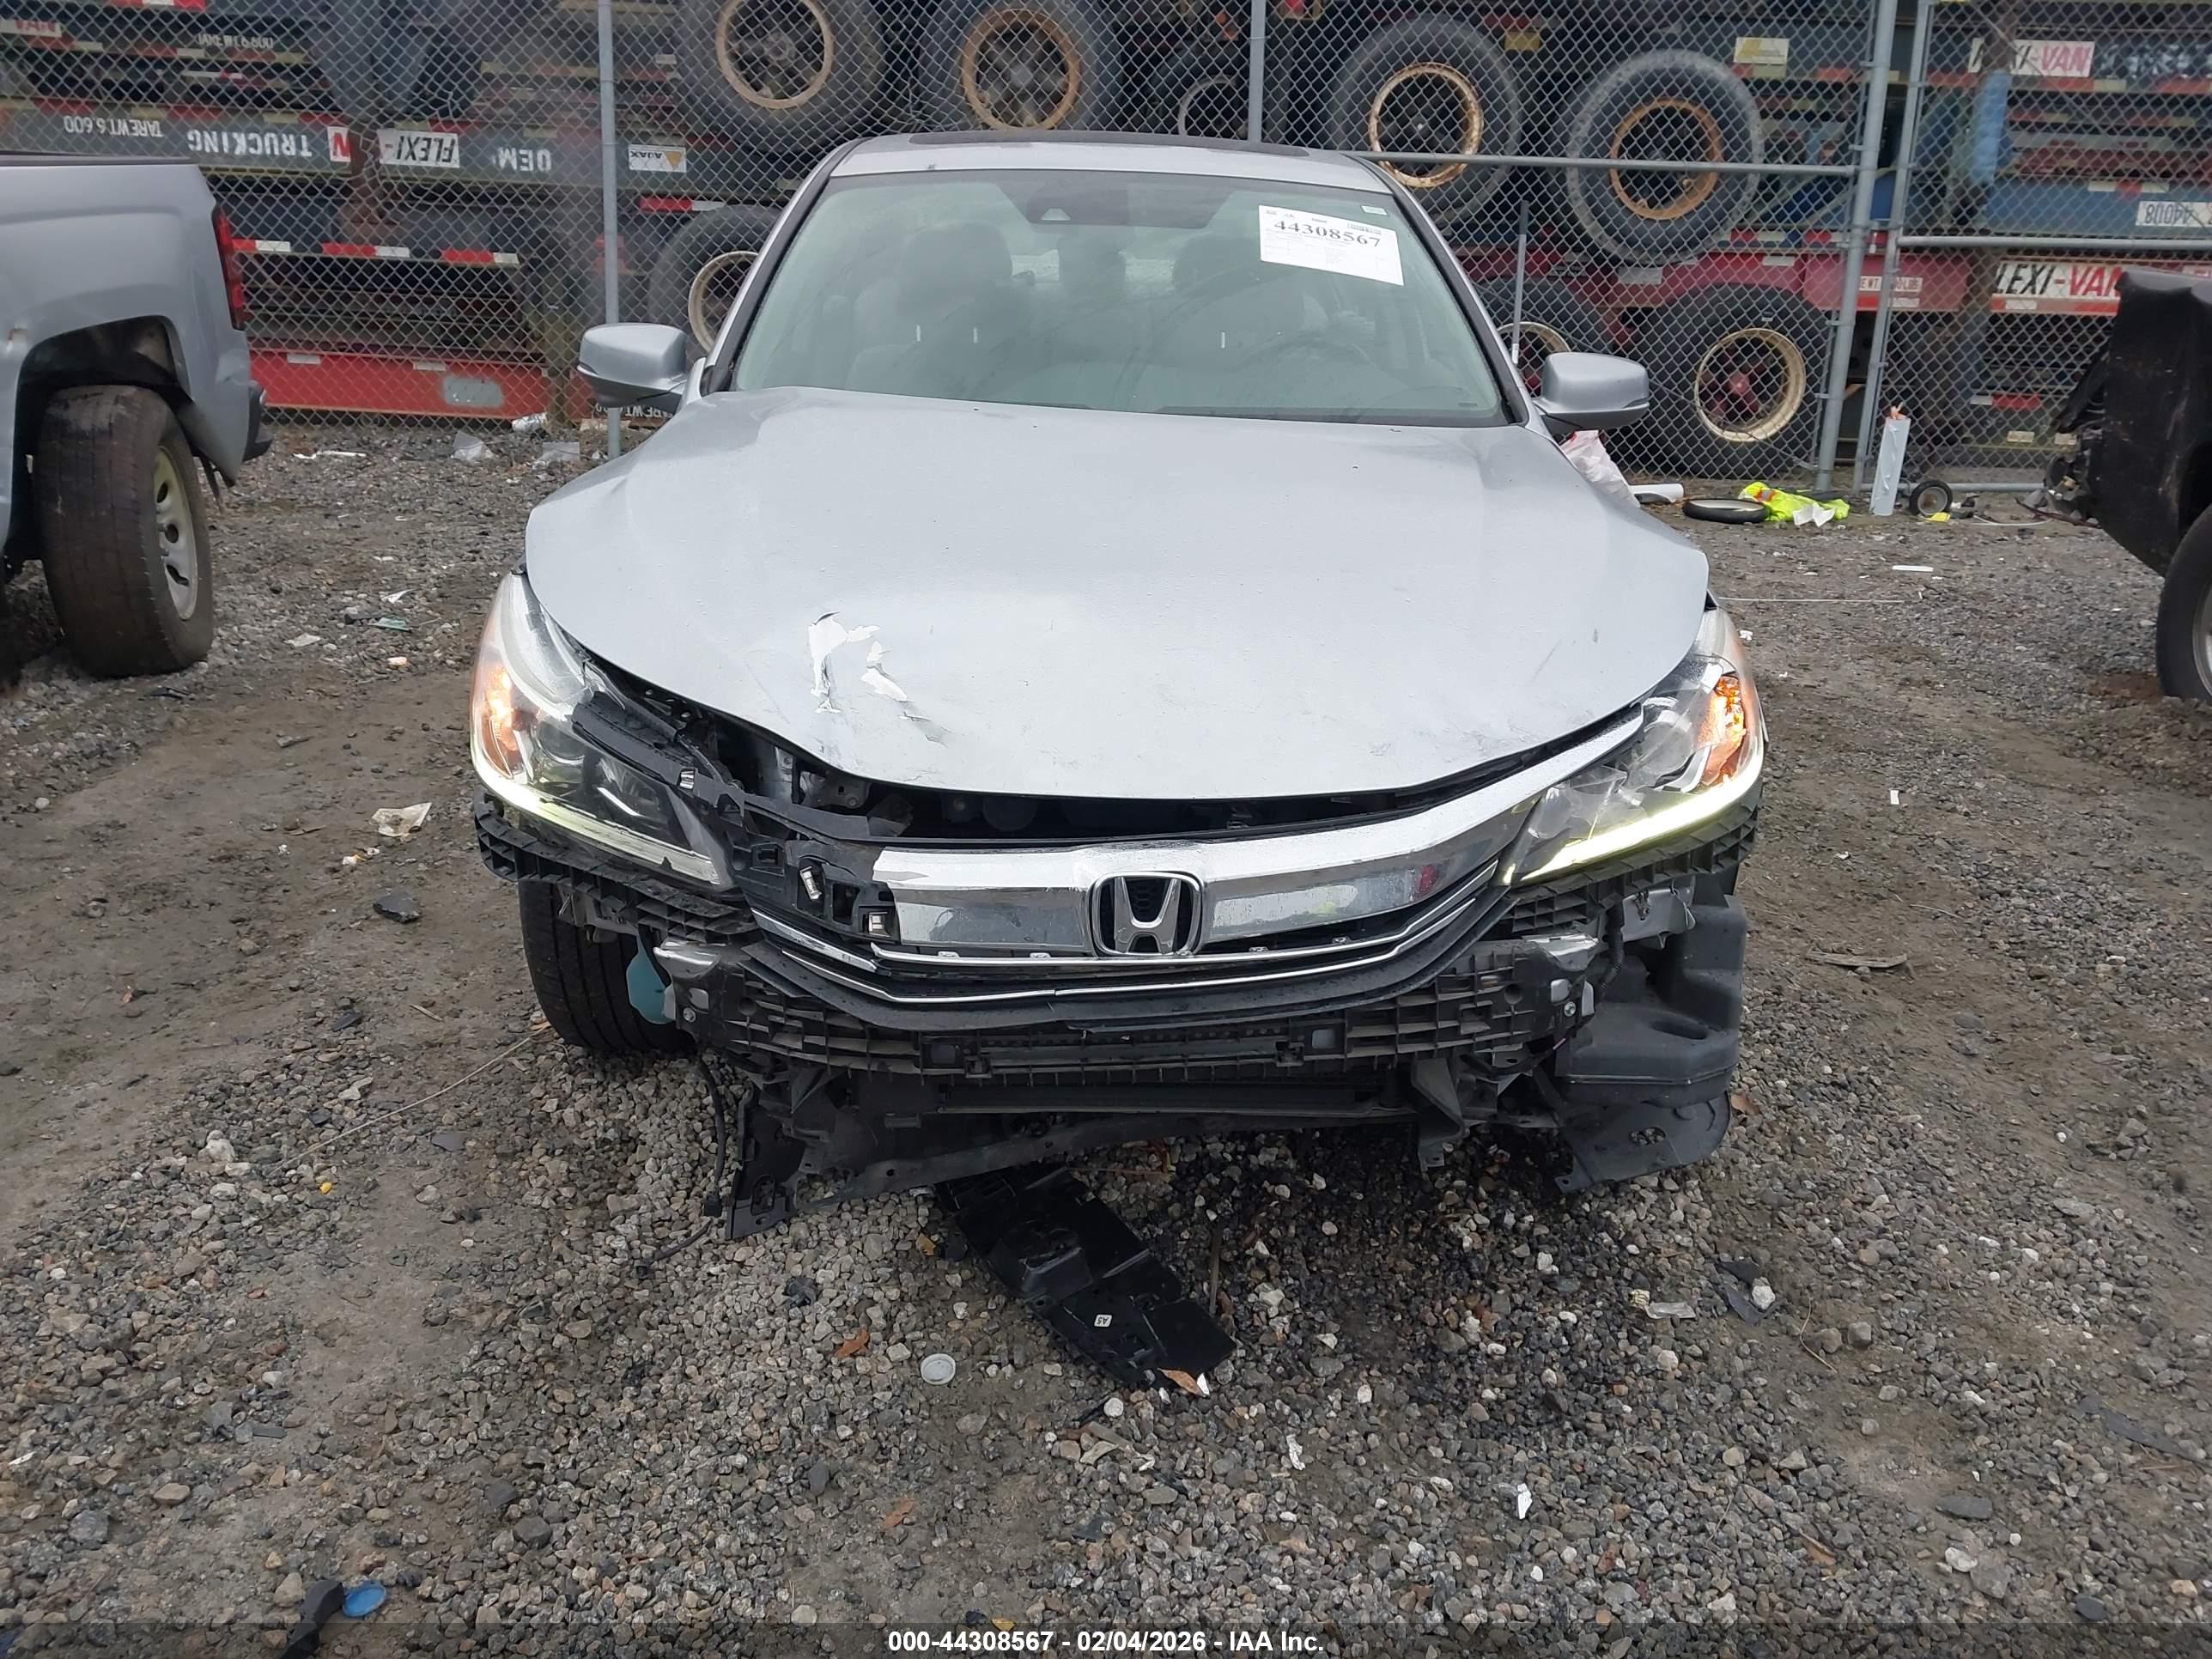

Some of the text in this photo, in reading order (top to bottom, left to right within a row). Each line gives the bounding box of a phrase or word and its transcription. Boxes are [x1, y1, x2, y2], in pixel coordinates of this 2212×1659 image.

[186, 129, 313, 157] TRUCKING
[497, 147, 552, 172] OEM
[1273, 220, 1381, 247] 44308567
